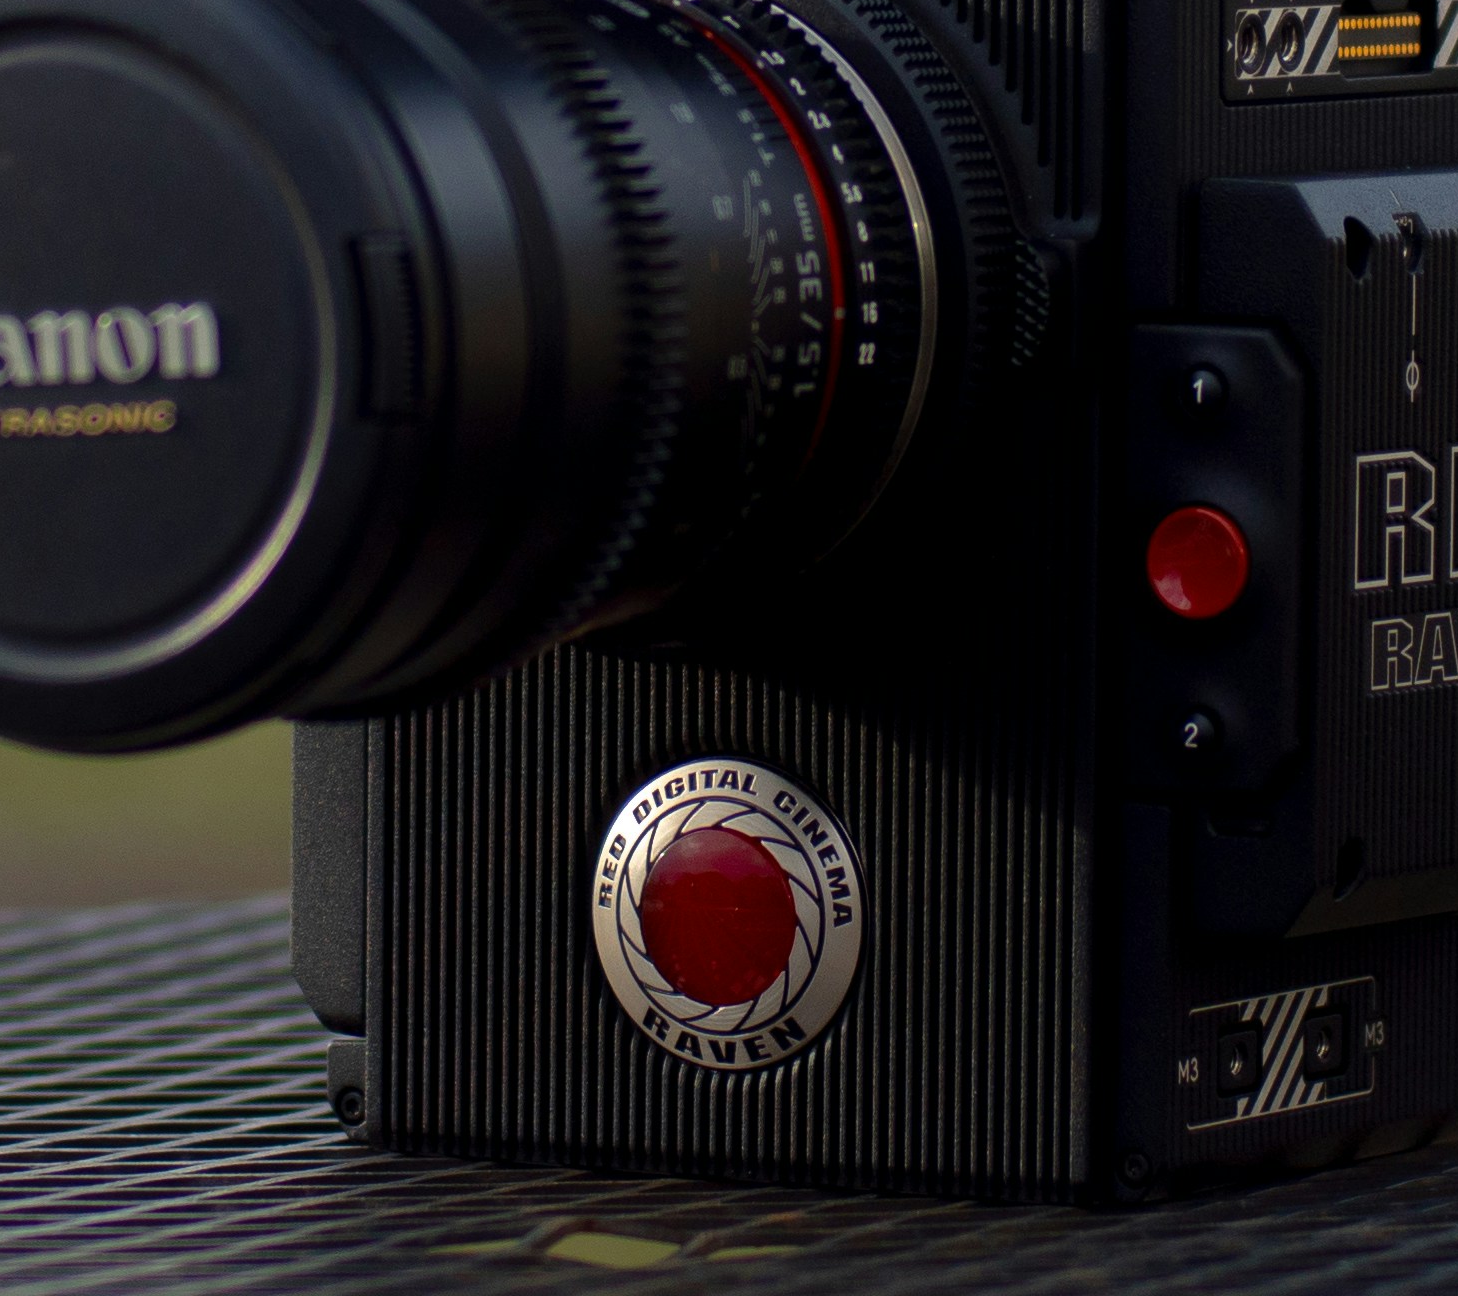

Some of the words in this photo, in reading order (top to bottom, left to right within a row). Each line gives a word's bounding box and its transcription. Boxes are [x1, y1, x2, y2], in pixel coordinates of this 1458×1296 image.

[858, 260, 876, 284] 11
[857, 341, 877, 367] 22
[1193, 378, 1203, 404] 1
[1184, 722, 1198, 748] 2
[597, 832, 627, 910] RED
[632, 768, 758, 825] DIGITAL
[772, 789, 854, 929] CINEMA
[643, 1005, 808, 1065] RAVEN
[1364, 1020, 1385, 1048] M3
[1177, 1056, 1199, 1085] M3
